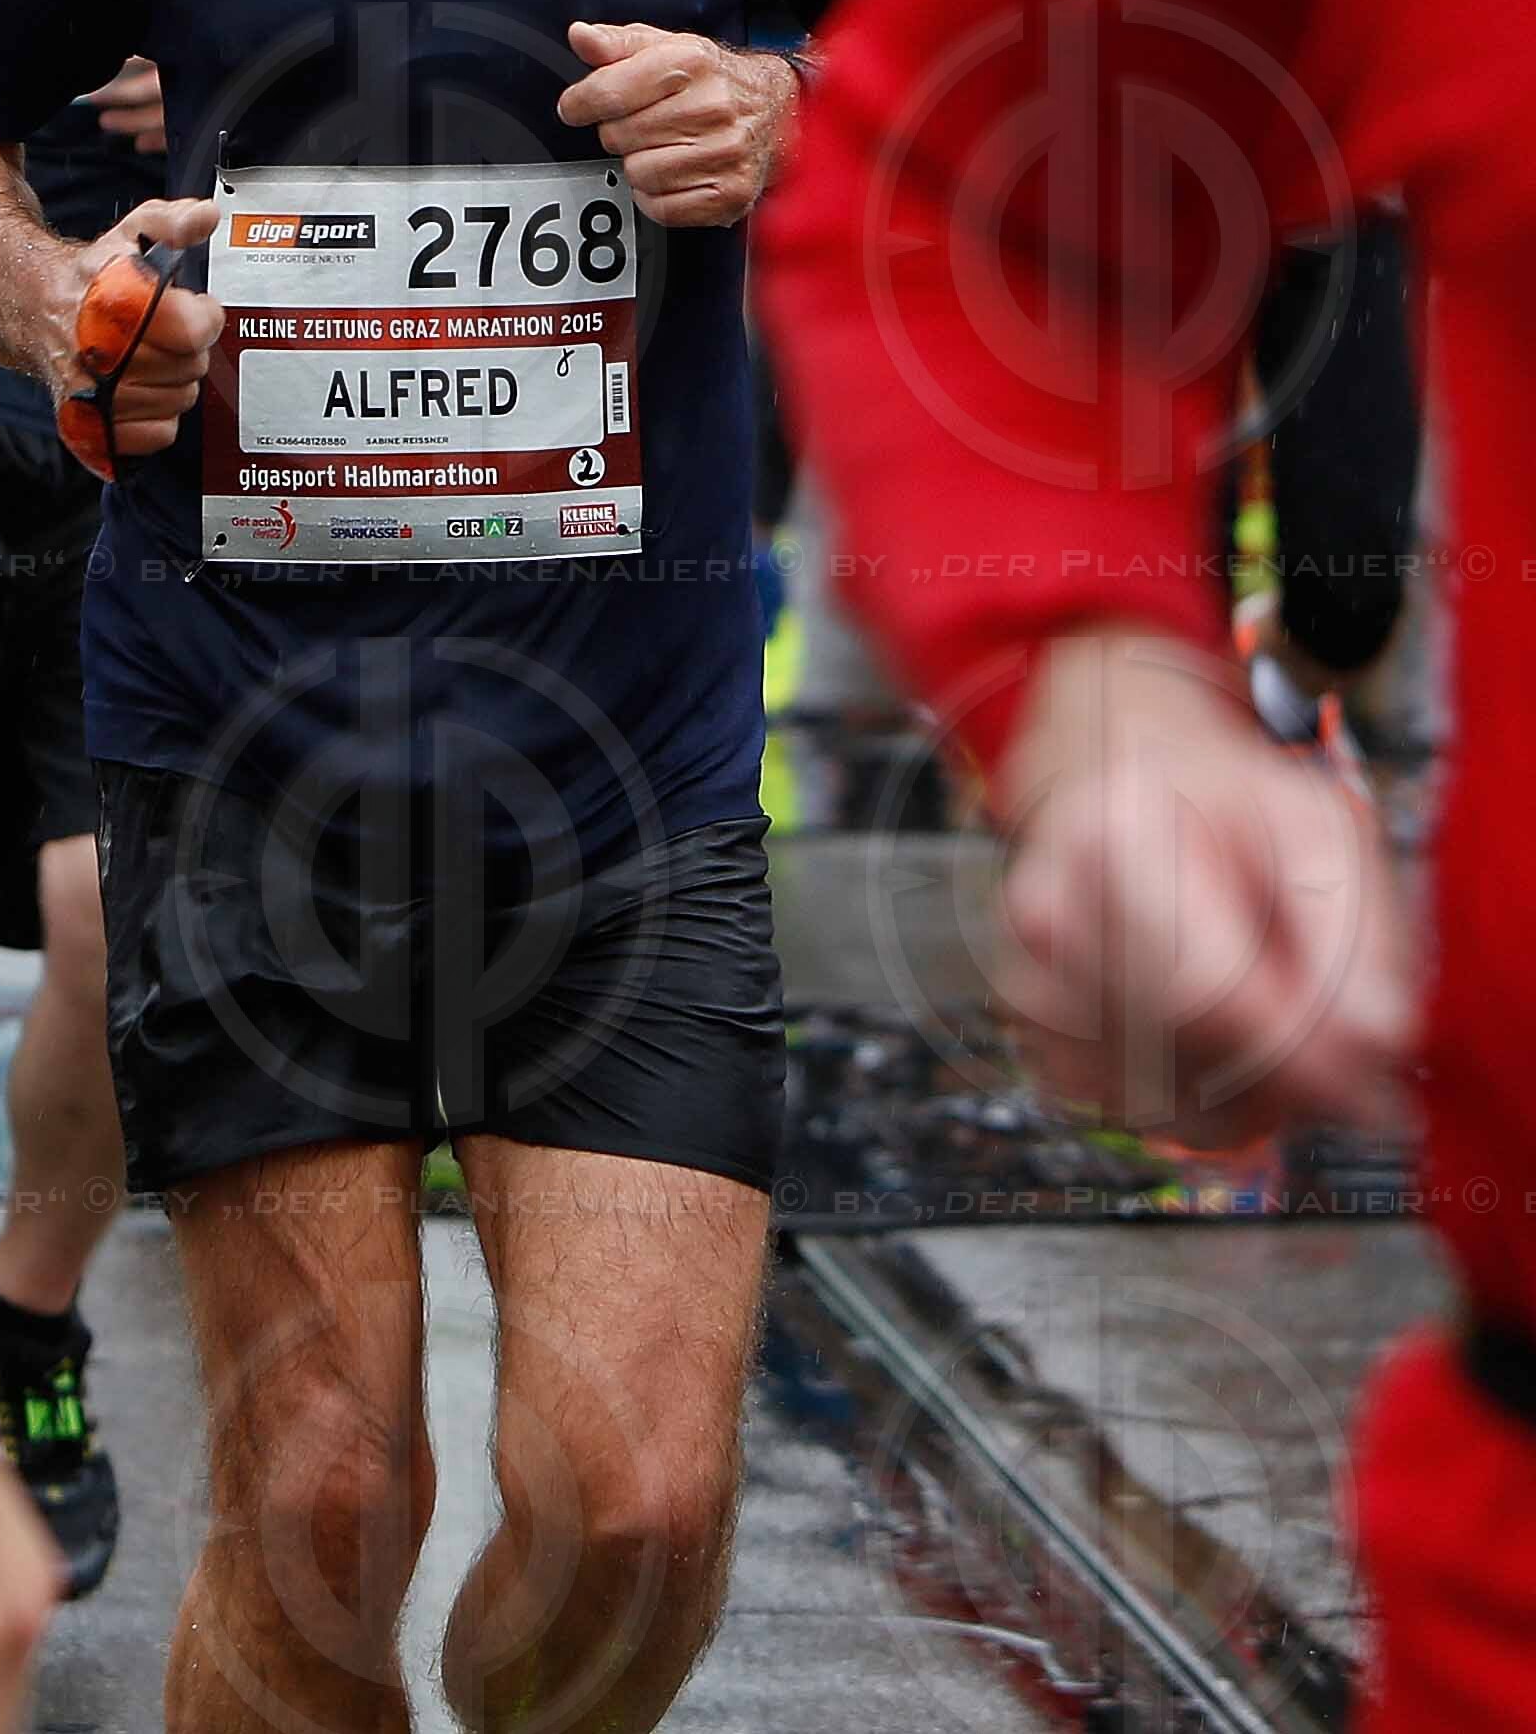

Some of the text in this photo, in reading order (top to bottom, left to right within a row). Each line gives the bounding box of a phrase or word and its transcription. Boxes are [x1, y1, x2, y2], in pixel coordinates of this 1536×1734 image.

[246, 219, 369, 244] giga sport
[407, 198, 627, 289] 2768
[239, 312, 603, 339] KLEINE ZEITUNG GRAZ MARATHON 2015
[323, 368, 519, 419] ALFRED
[239, 463, 498, 491] gigasport Halbmarathon
[231, 516, 283, 527] Get active
[562, 506, 614, 522] KLEINE
[330, 527, 399, 539] SPARKASSE
[448, 517, 521, 537] GRAZ
[562, 522, 616, 536] ZEITUNG
